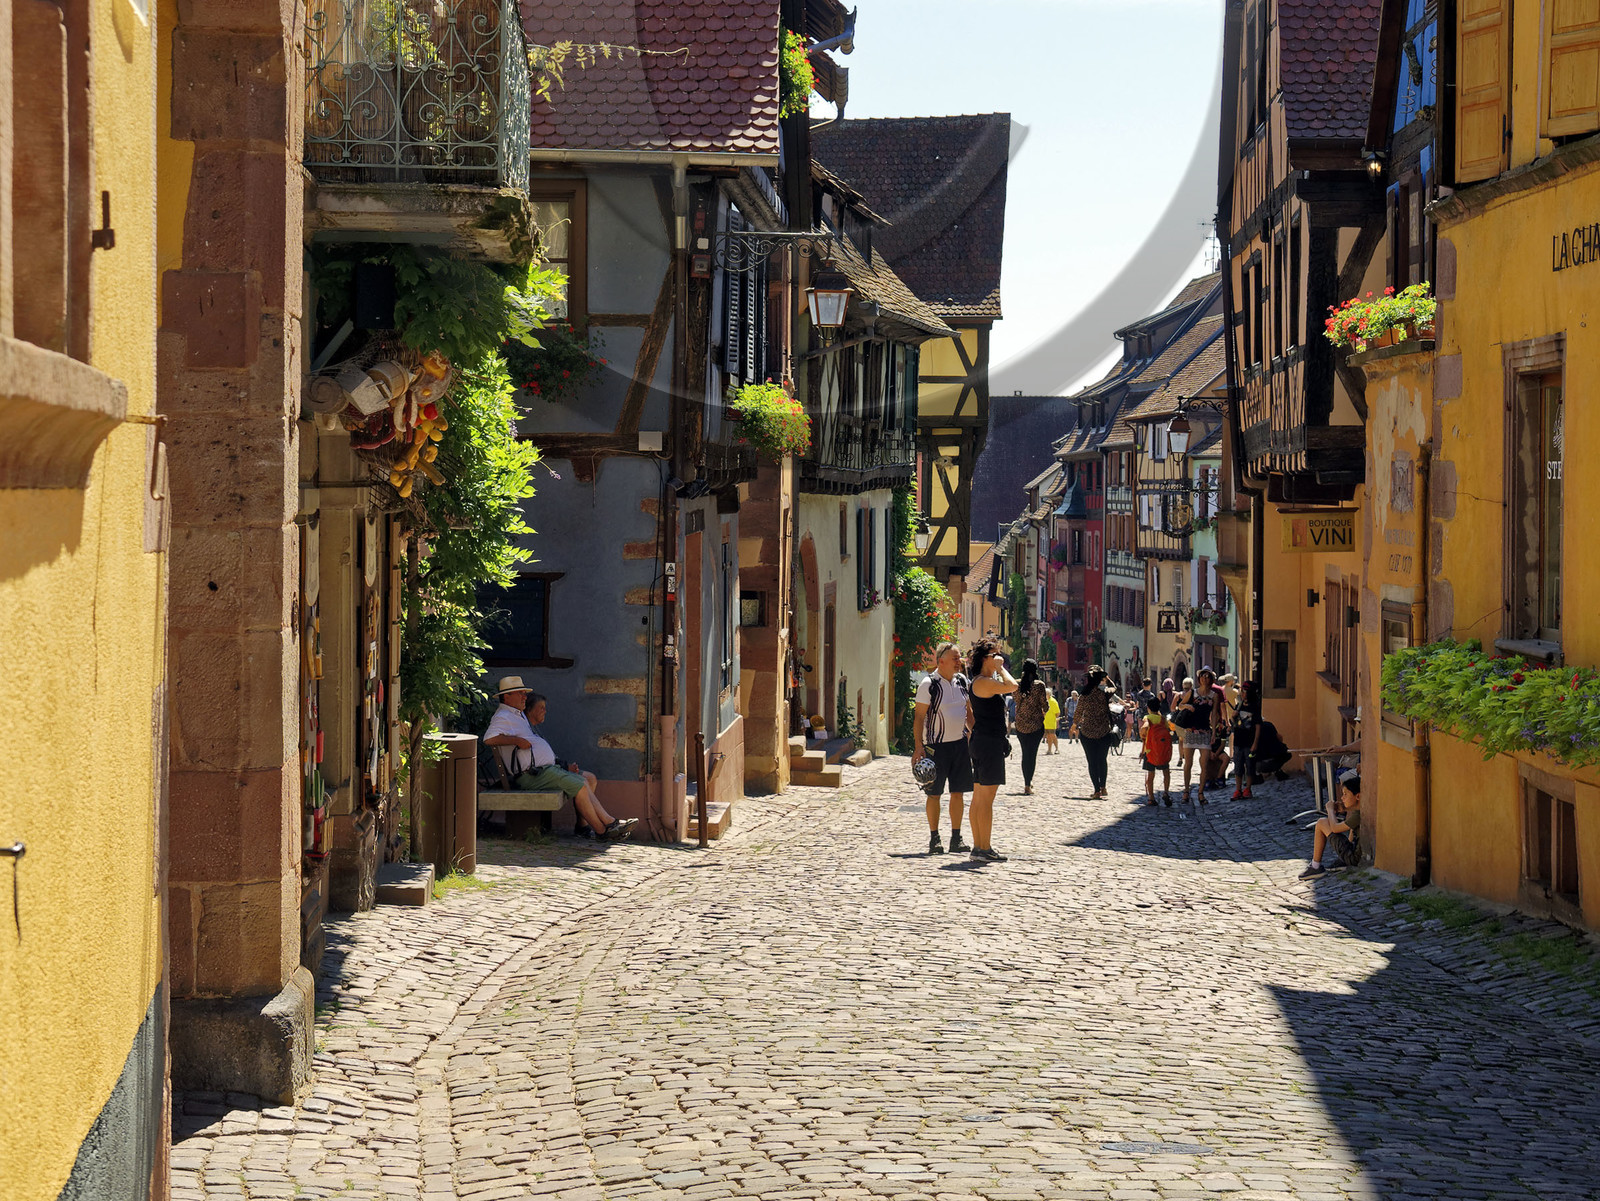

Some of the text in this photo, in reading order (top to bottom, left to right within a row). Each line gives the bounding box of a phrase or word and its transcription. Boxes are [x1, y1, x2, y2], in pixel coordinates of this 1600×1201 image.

[1552, 232, 1569, 272] LA
[1309, 519, 1352, 528] BOUTIQUE
[1310, 527, 1352, 546] VINI
